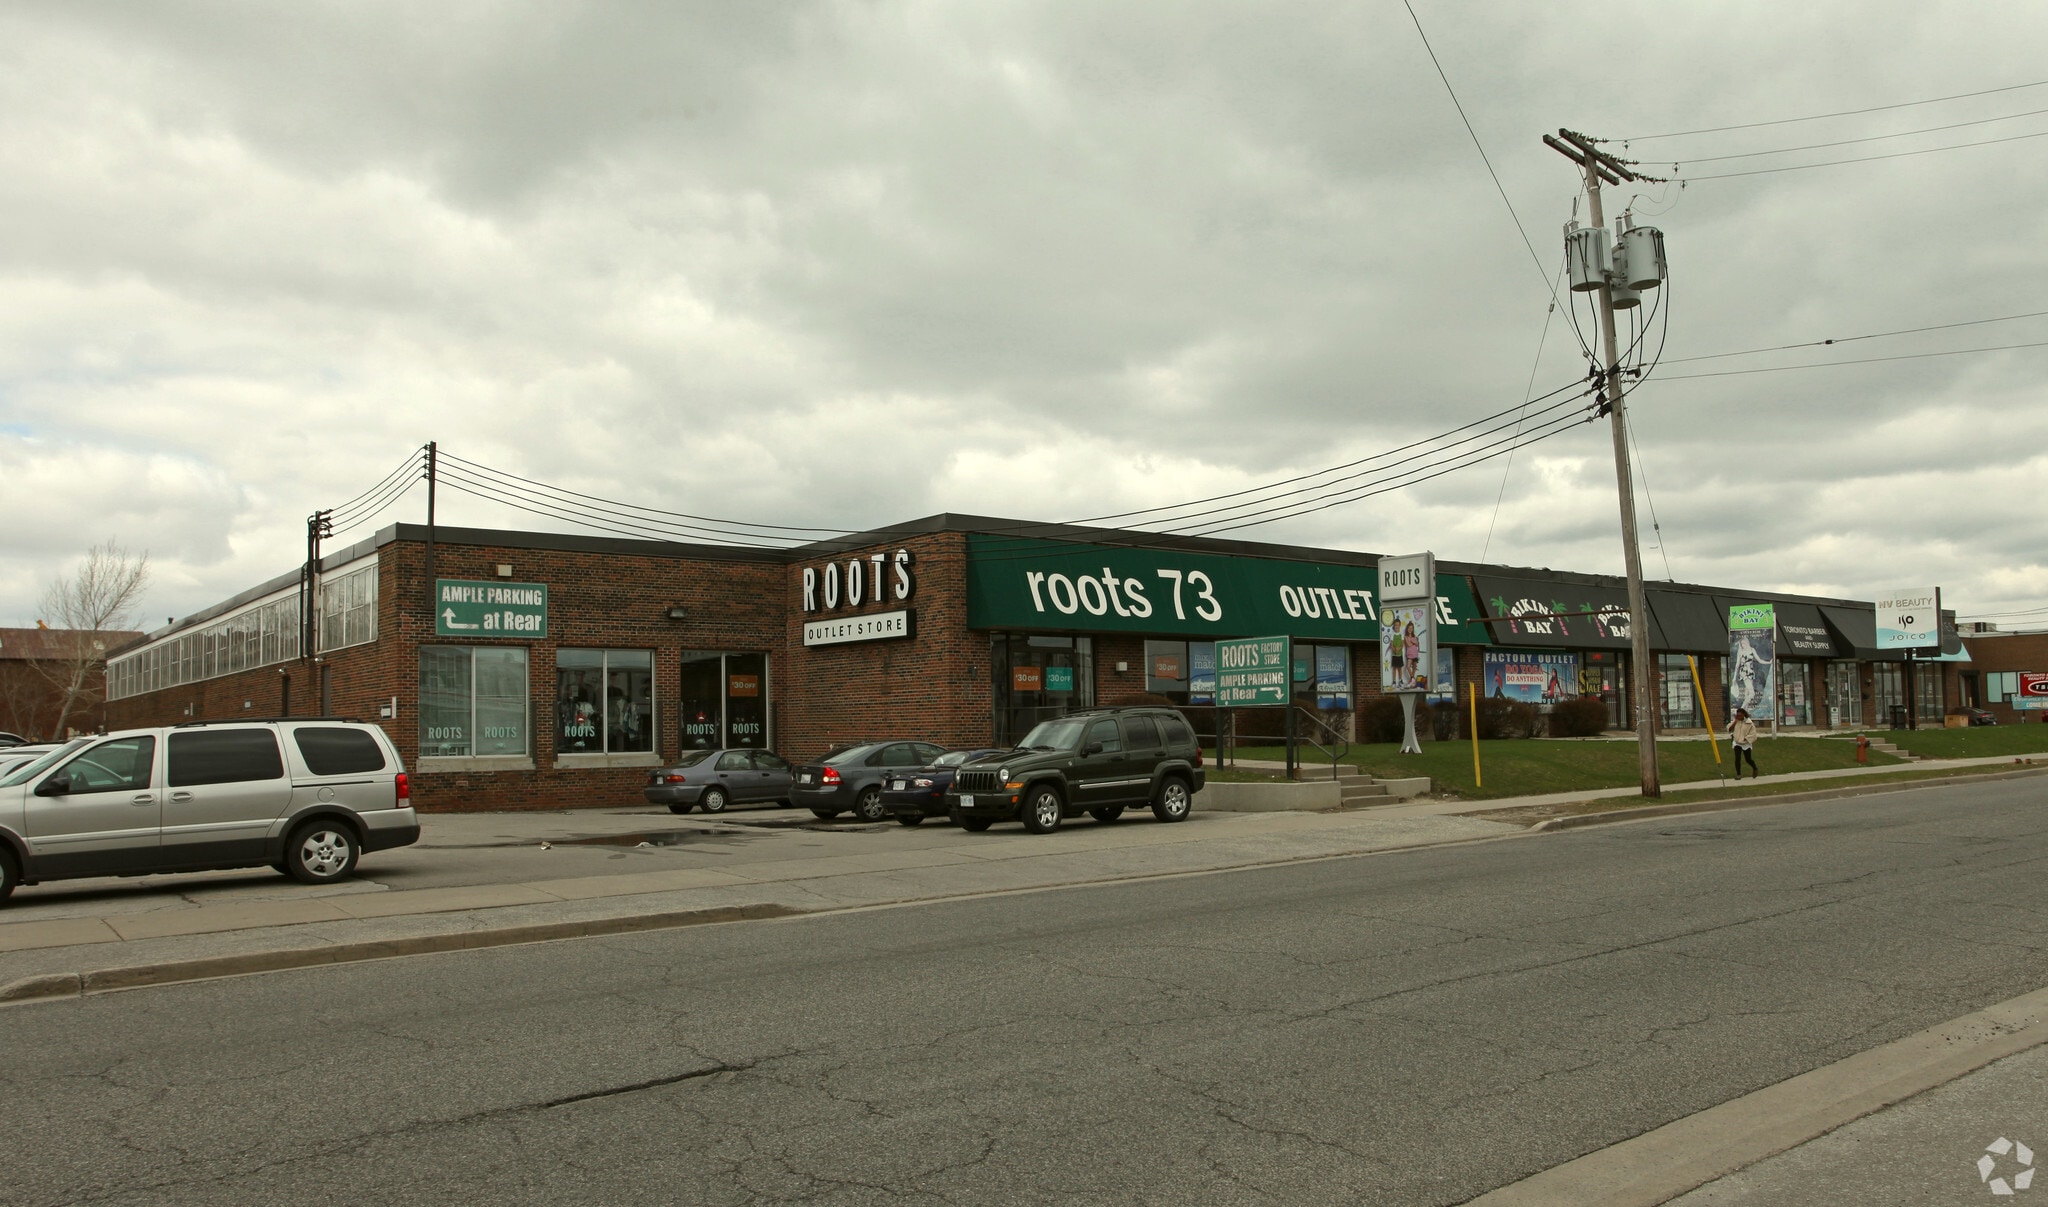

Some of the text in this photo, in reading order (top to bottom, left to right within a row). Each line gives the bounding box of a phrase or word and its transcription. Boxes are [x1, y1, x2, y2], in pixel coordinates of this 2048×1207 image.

[803, 549, 909, 611] ROOTS
[1384, 568, 1420, 588] ROOTS
[442, 585, 542, 606] AMPLE PARKING
[1026, 567, 1222, 621] roots 73
[1279, 585, 1377, 621] OUTLET
[1896, 597, 1932, 607] BEAUTY
[1739, 608, 1764, 619] BIKINI
[483, 611, 542, 631] at Rear
[1524, 620, 1553, 634] BAY
[1898, 614, 1914, 630] ISO
[808, 618, 902, 640] OUTLET STORE
[1889, 633, 1926, 641] JOICO
[1221, 641, 1283, 668] ROOTS FACTORY
[1264, 653, 1280, 665] STORE
[1485, 653, 1574, 664] FACTORY OUTLET
[1320, 663, 1344, 672] match
[1220, 674, 1246, 688] AMPLE
[1247, 672, 1284, 686] PARKING
[1220, 688, 1230, 701] at
[1232, 687, 1257, 700] Rear
[428, 726, 462, 739] ROOTS
[484, 726, 517, 739] ROOTS
[564, 725, 595, 738] ROOTS
[687, 723, 714, 735] ROOTS
[732, 723, 759, 734] ROOTS
